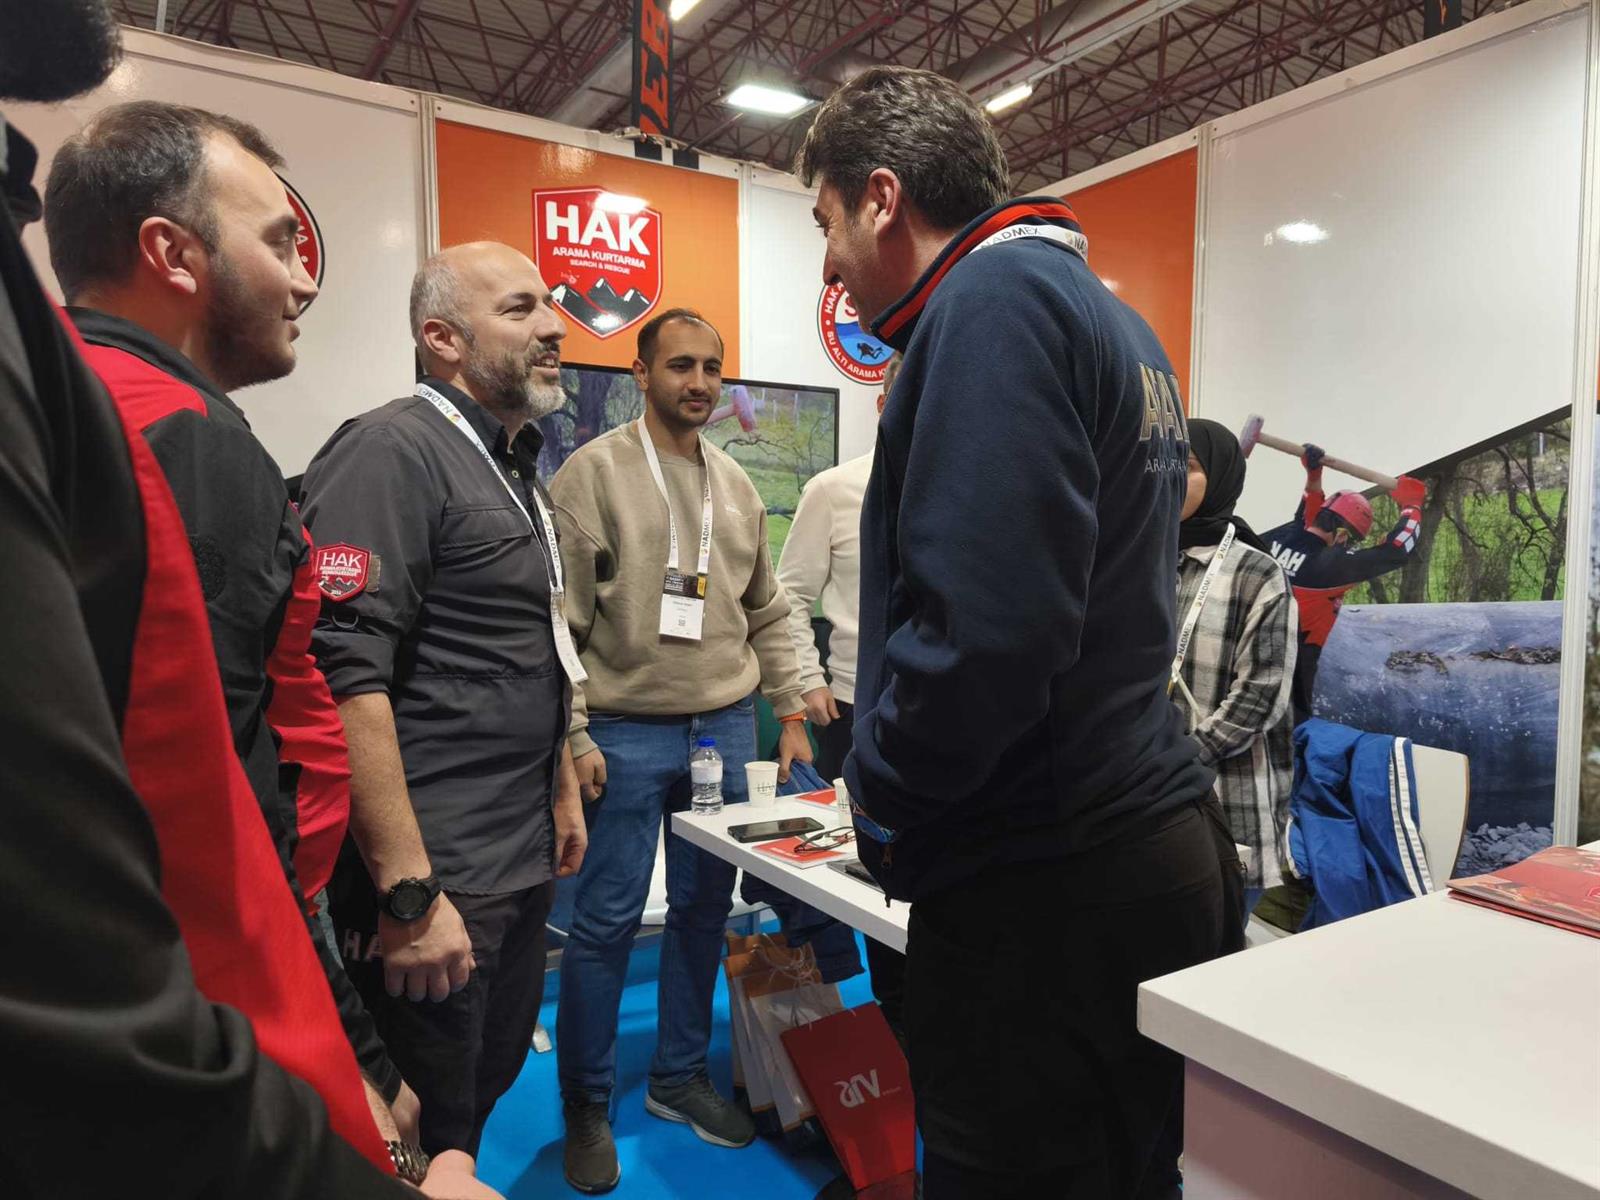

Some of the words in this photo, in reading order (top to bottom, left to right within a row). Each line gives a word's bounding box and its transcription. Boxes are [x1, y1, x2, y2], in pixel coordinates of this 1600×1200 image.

[545, 201, 651, 256] HAK
[552, 246, 590, 260] ARAMA
[591, 250, 646, 270] KURTARMA
[570, 259, 598, 269] SEARCH
[604, 263, 631, 275] RESCUE
[824, 287, 839, 314] HAK
[827, 330, 837, 346] SU
[832, 347, 849, 368] ALTI
[847, 363, 878, 378] ARAMA
[322, 552, 363, 568] HAK
